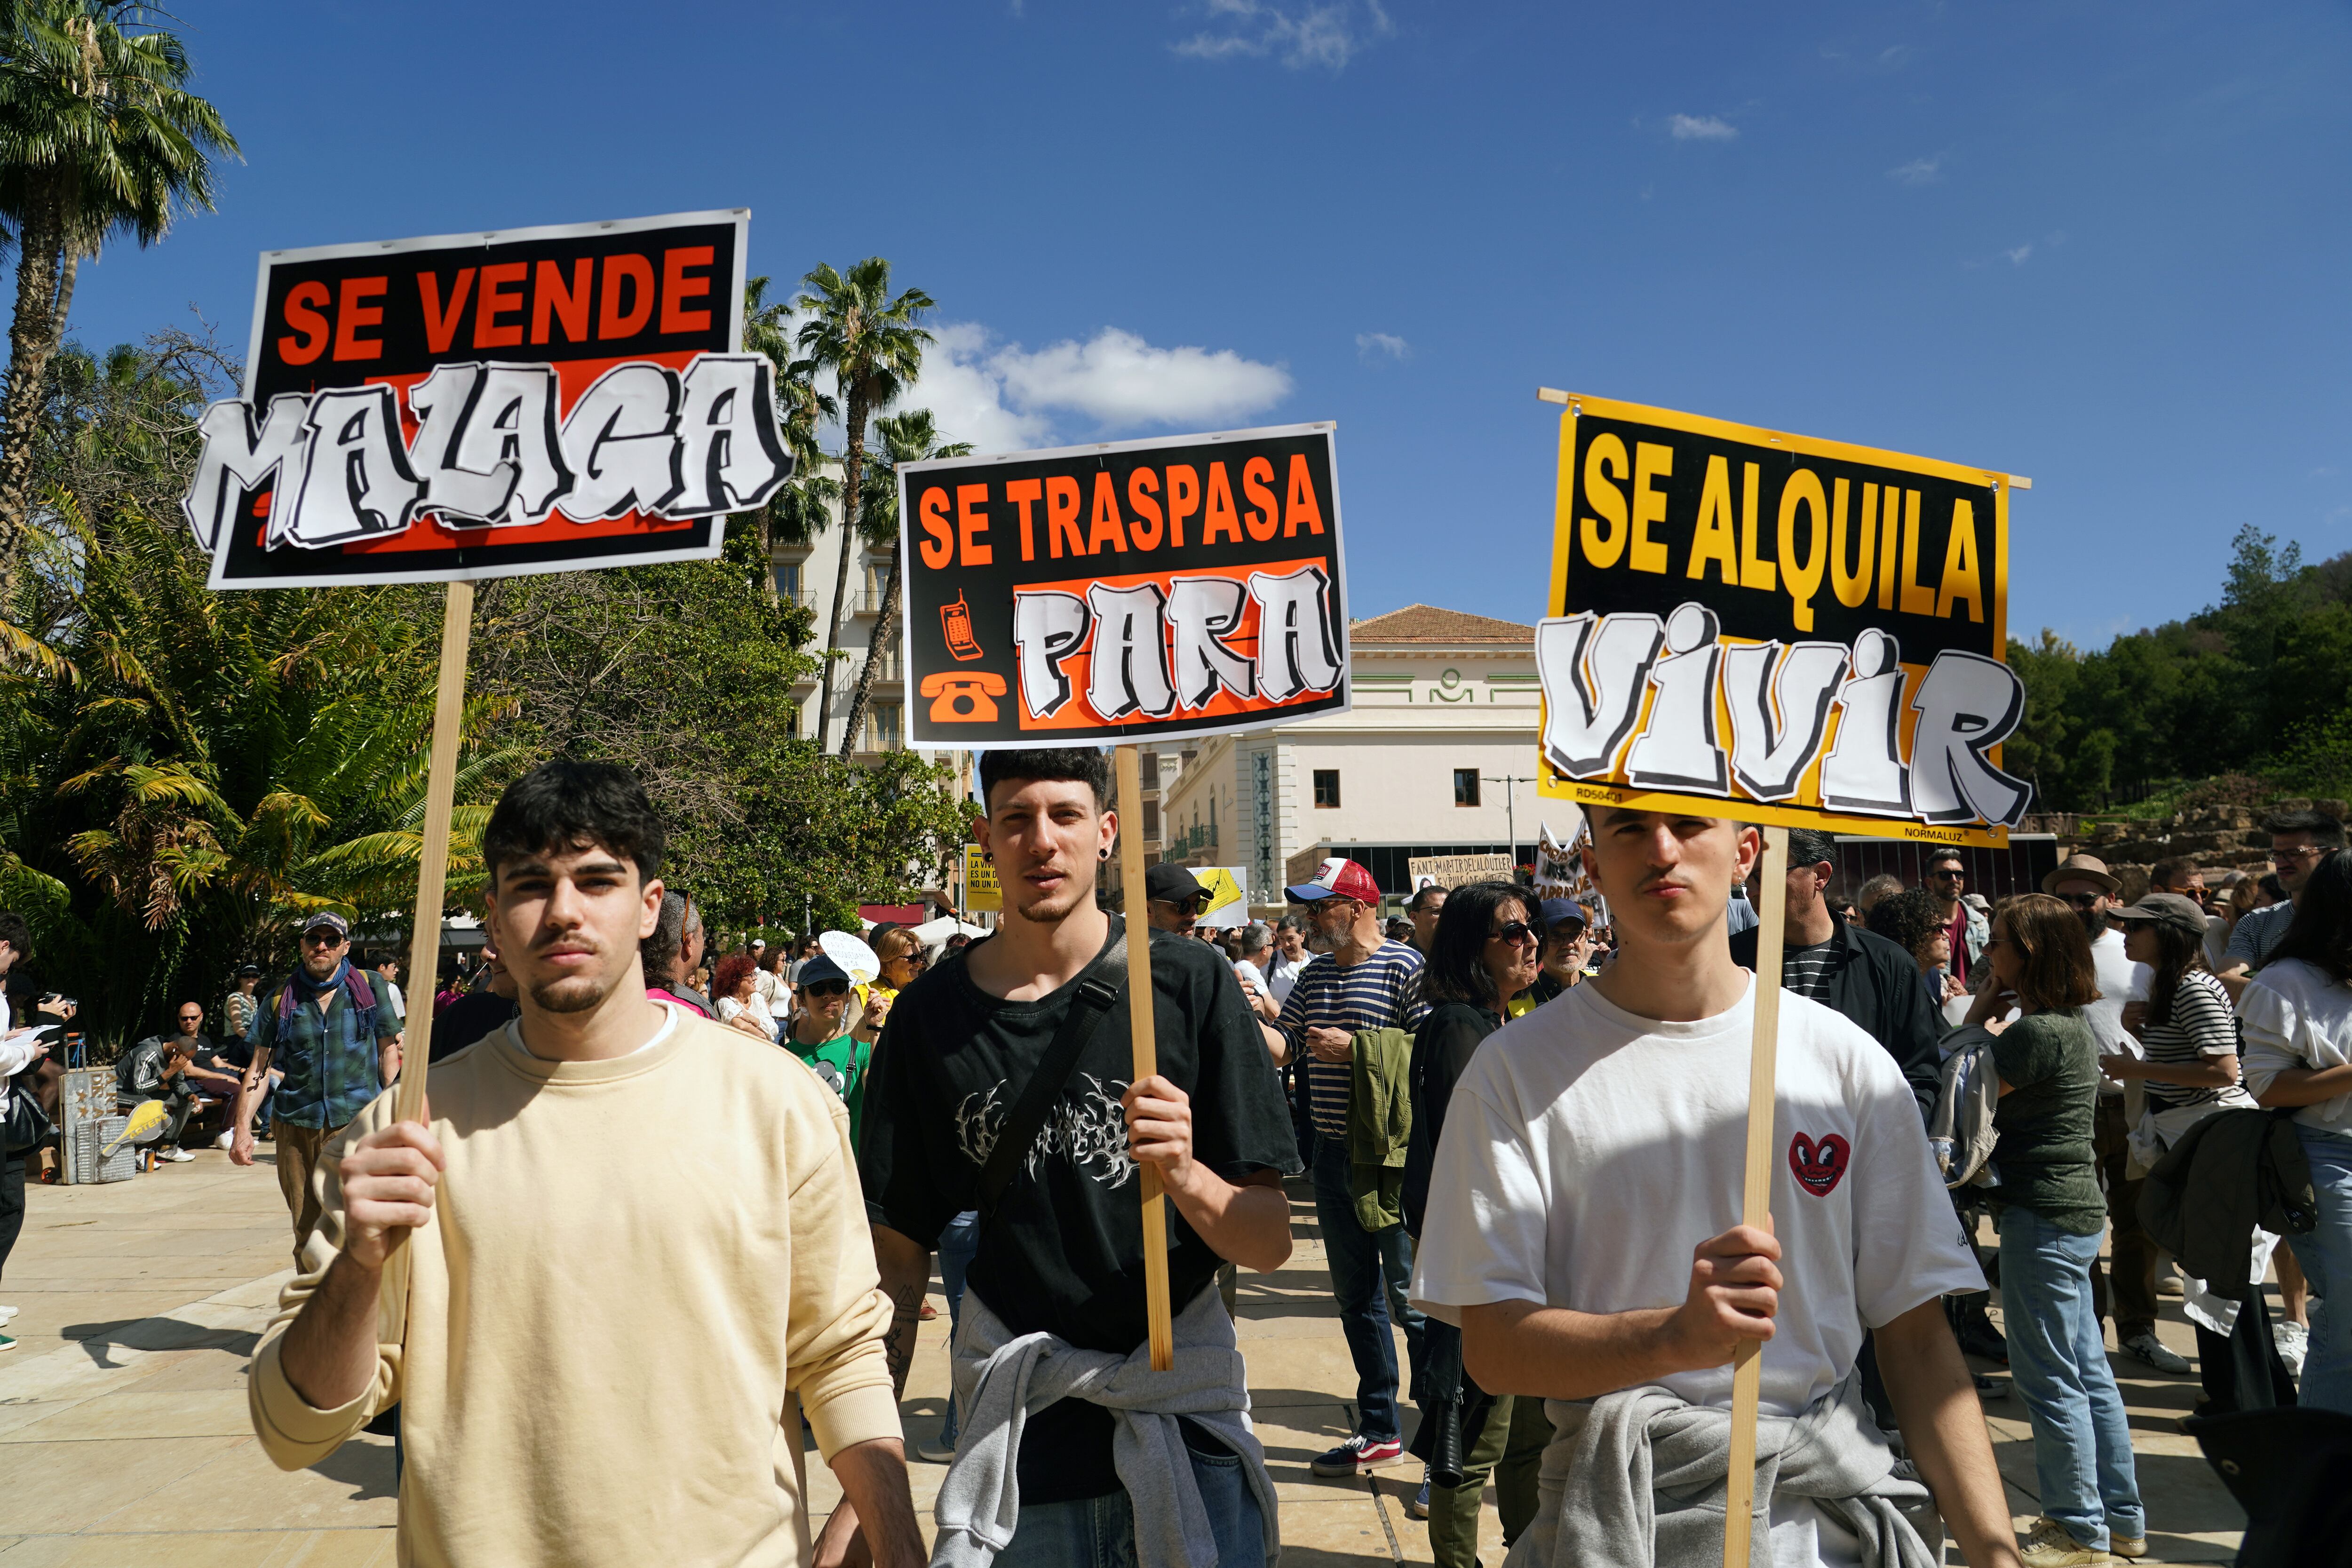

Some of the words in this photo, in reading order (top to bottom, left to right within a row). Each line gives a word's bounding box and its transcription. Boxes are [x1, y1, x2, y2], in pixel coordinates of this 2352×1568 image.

[278, 276, 388, 366] SE
[417, 246, 715, 354] VENDE
[182, 352, 796, 552] MALAGA
[919, 483, 993, 569] SE
[1006, 453, 1325, 561] TRASPASA
[1579, 432, 1674, 574] SE
[1685, 454, 1984, 632] ALQUILA
[1013, 564, 1344, 721] PARA
[1576, 788, 1622, 803] RD50401
[824, 940, 846, 949] PARA
